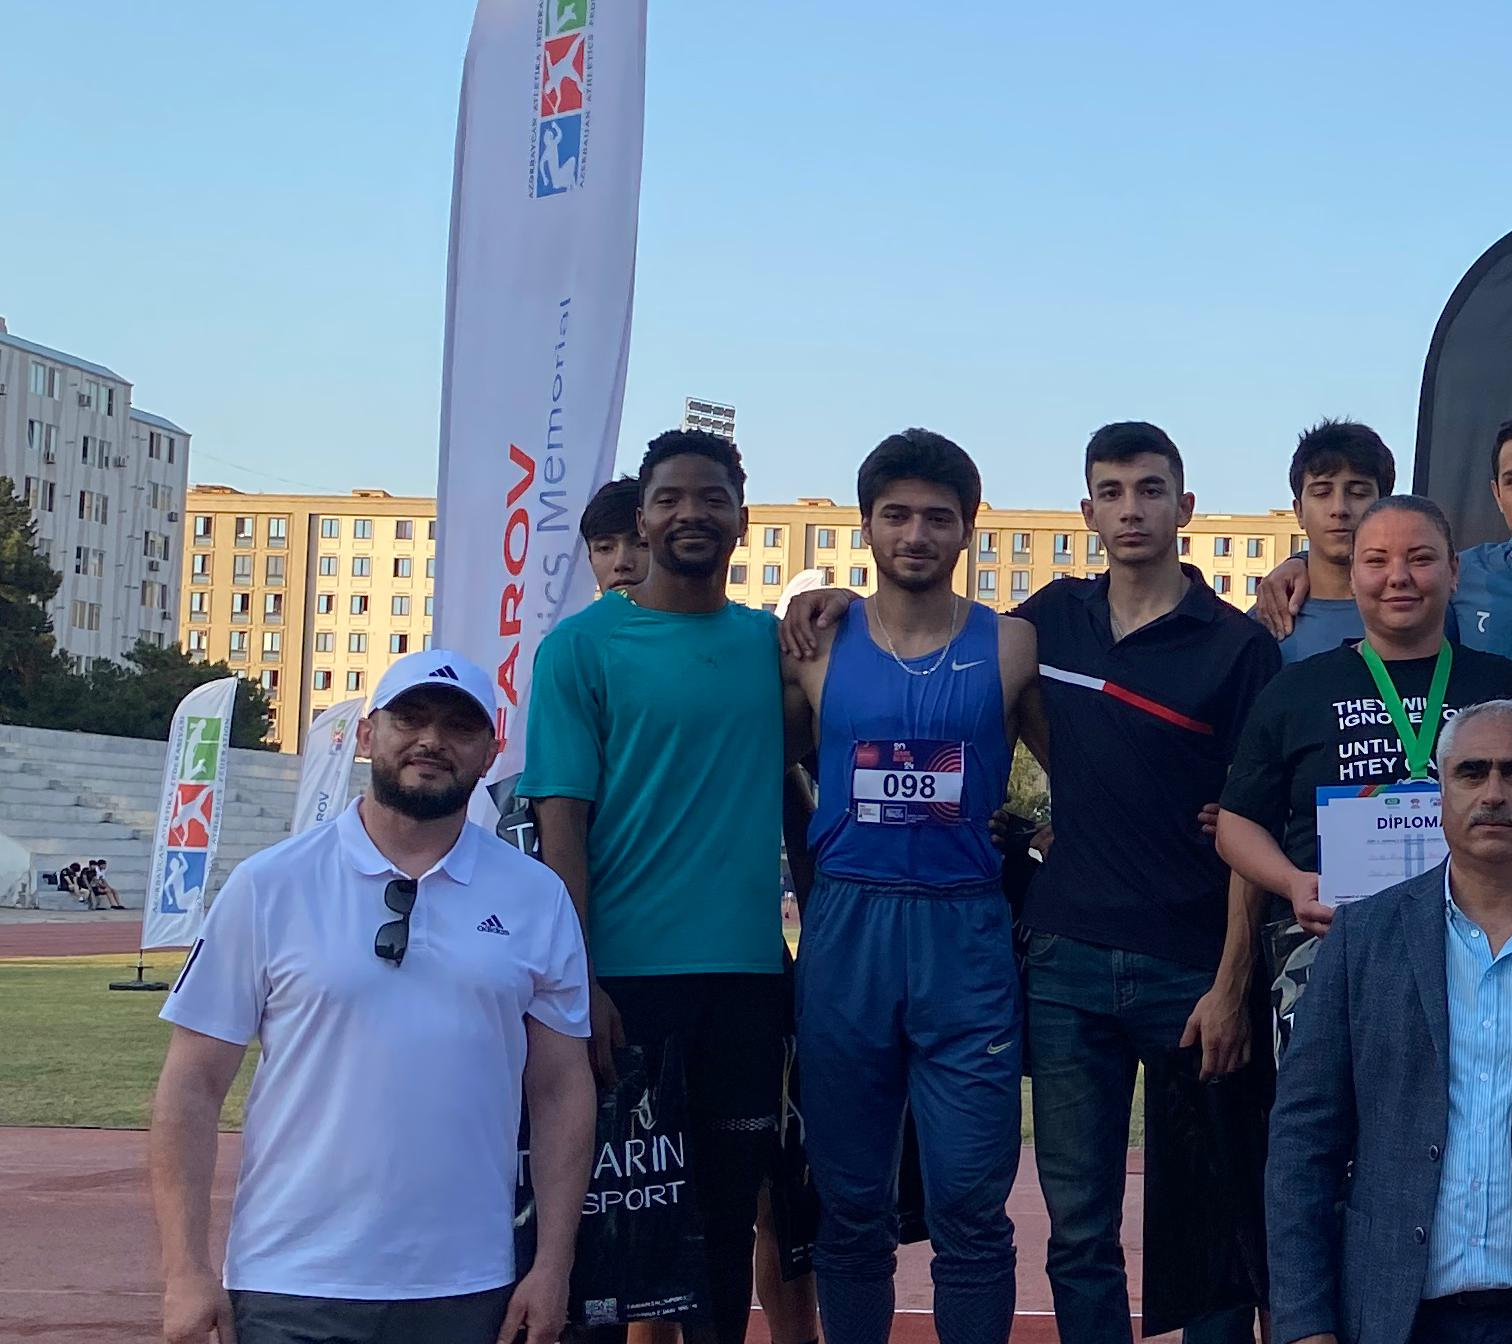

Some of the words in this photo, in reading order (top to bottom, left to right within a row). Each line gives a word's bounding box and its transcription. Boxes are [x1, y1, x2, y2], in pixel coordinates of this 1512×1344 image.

[532, 297, 572, 533] Memorial
[1333, 699, 1386, 716] THEY
[1338, 711, 1423, 730] IGNOE
[1339, 757, 1397, 781] HTEY
[883, 773, 936, 799] 098
[1377, 813, 1443, 830] DİPLOM
[477, 924, 510, 936] adidas
[581, 1180, 686, 1215] SPORT
